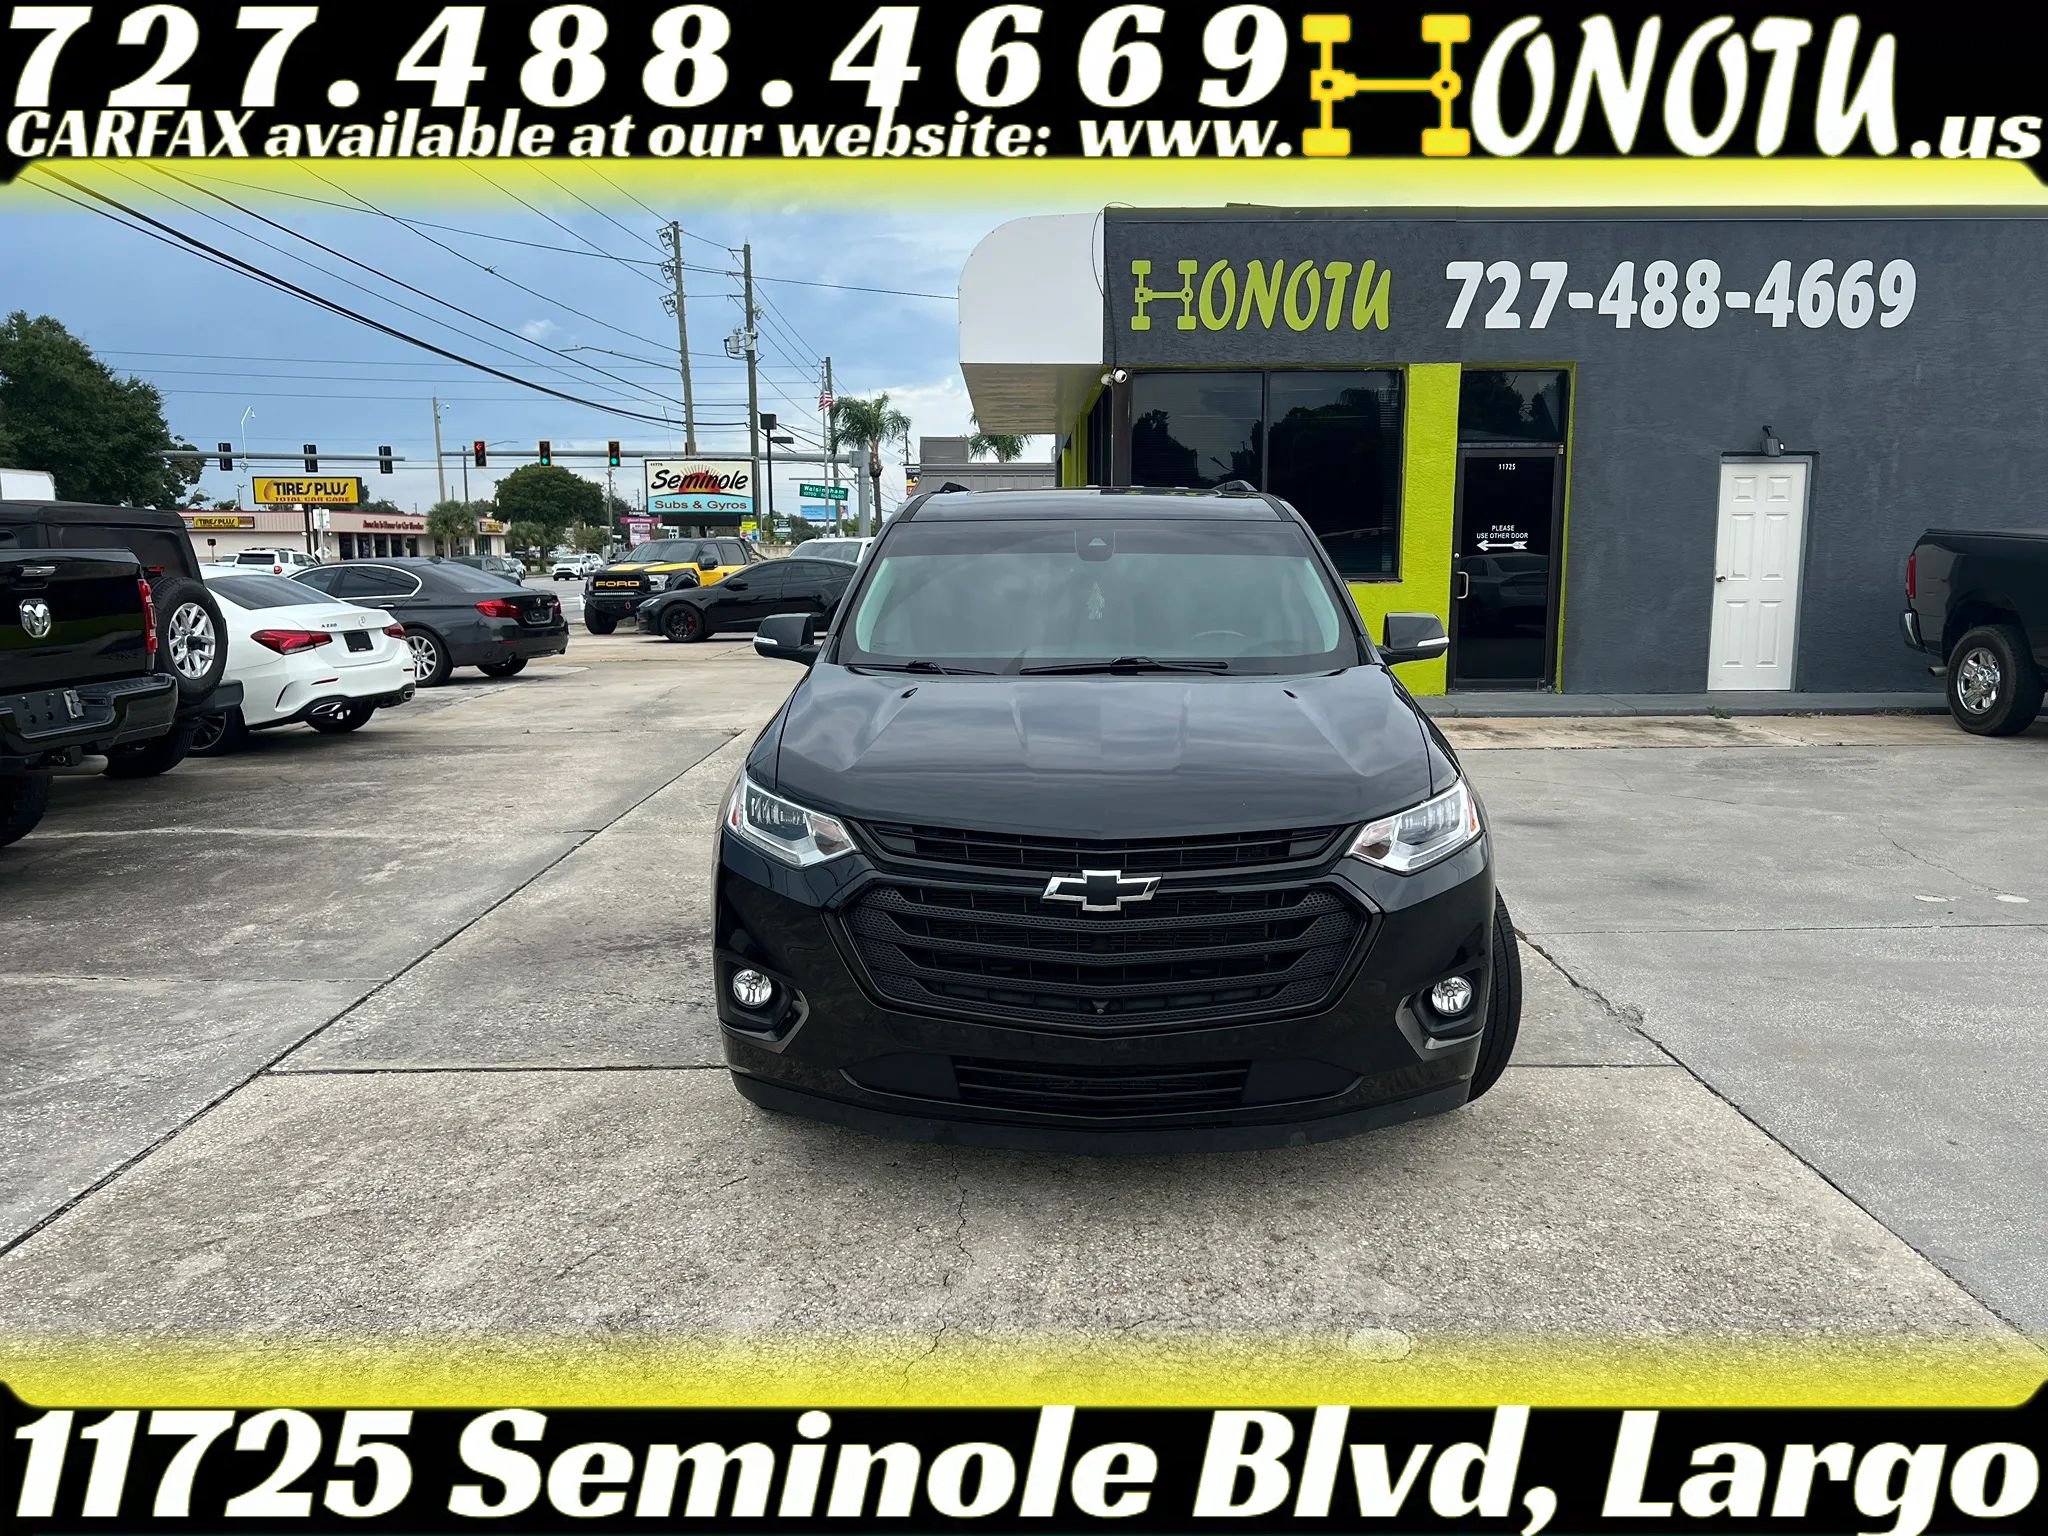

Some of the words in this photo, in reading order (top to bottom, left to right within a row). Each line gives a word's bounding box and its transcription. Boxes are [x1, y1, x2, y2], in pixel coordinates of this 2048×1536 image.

[1445, 258, 1917, 329] 727-488-4669
[1498, 463, 1516, 471] 11725
[650, 469, 749, 490] Seminole
[273, 482, 312, 496] TIRES
[314, 482, 349, 496] PLUS
[654, 500, 688, 509] Subs
[692, 500, 702, 509] &
[707, 500, 747, 511] Gyros
[1491, 524, 1515, 532] PLEASE
